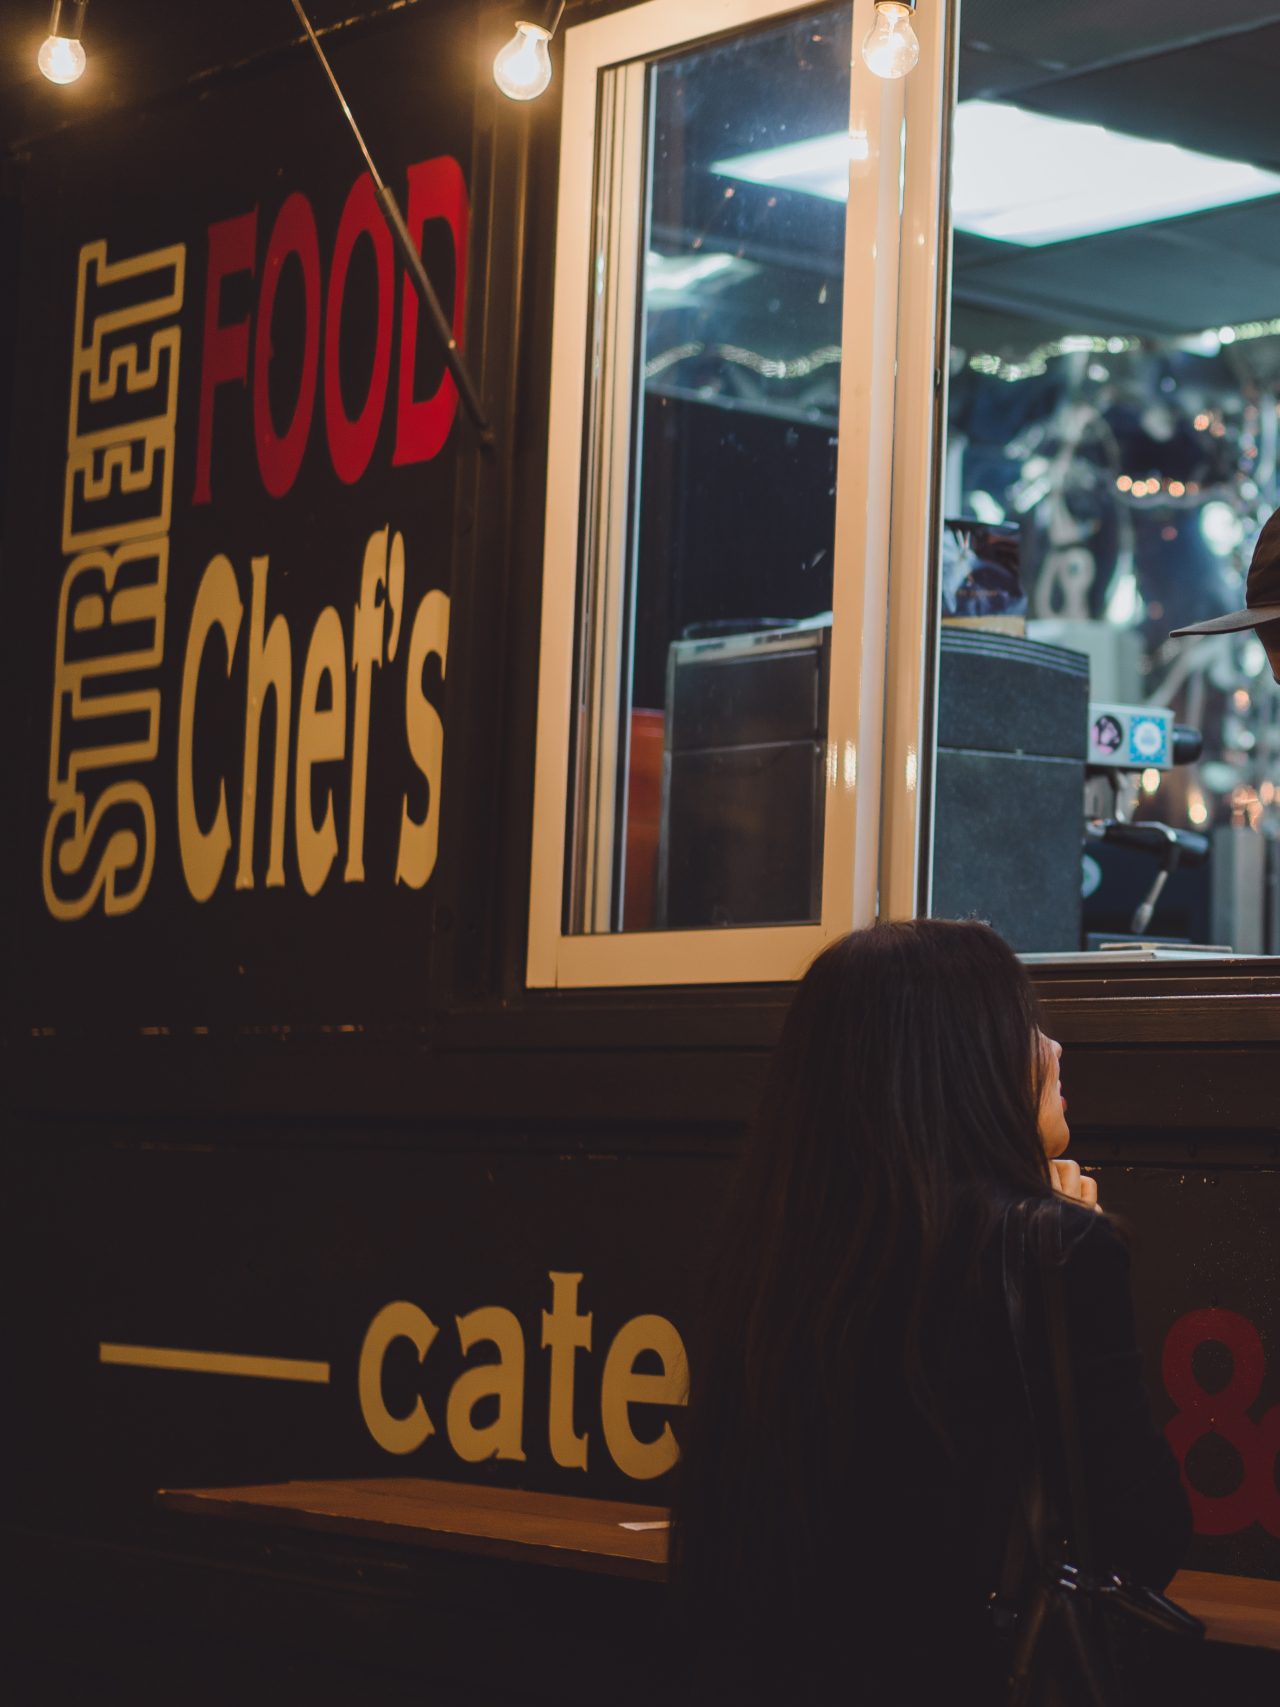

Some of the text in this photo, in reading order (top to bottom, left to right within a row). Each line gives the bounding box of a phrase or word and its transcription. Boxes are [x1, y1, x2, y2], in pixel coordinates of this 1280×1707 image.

[192, 155, 470, 506] FOOD
[42, 239, 188, 922] STREET
[176, 523, 452, 904] Chef's
